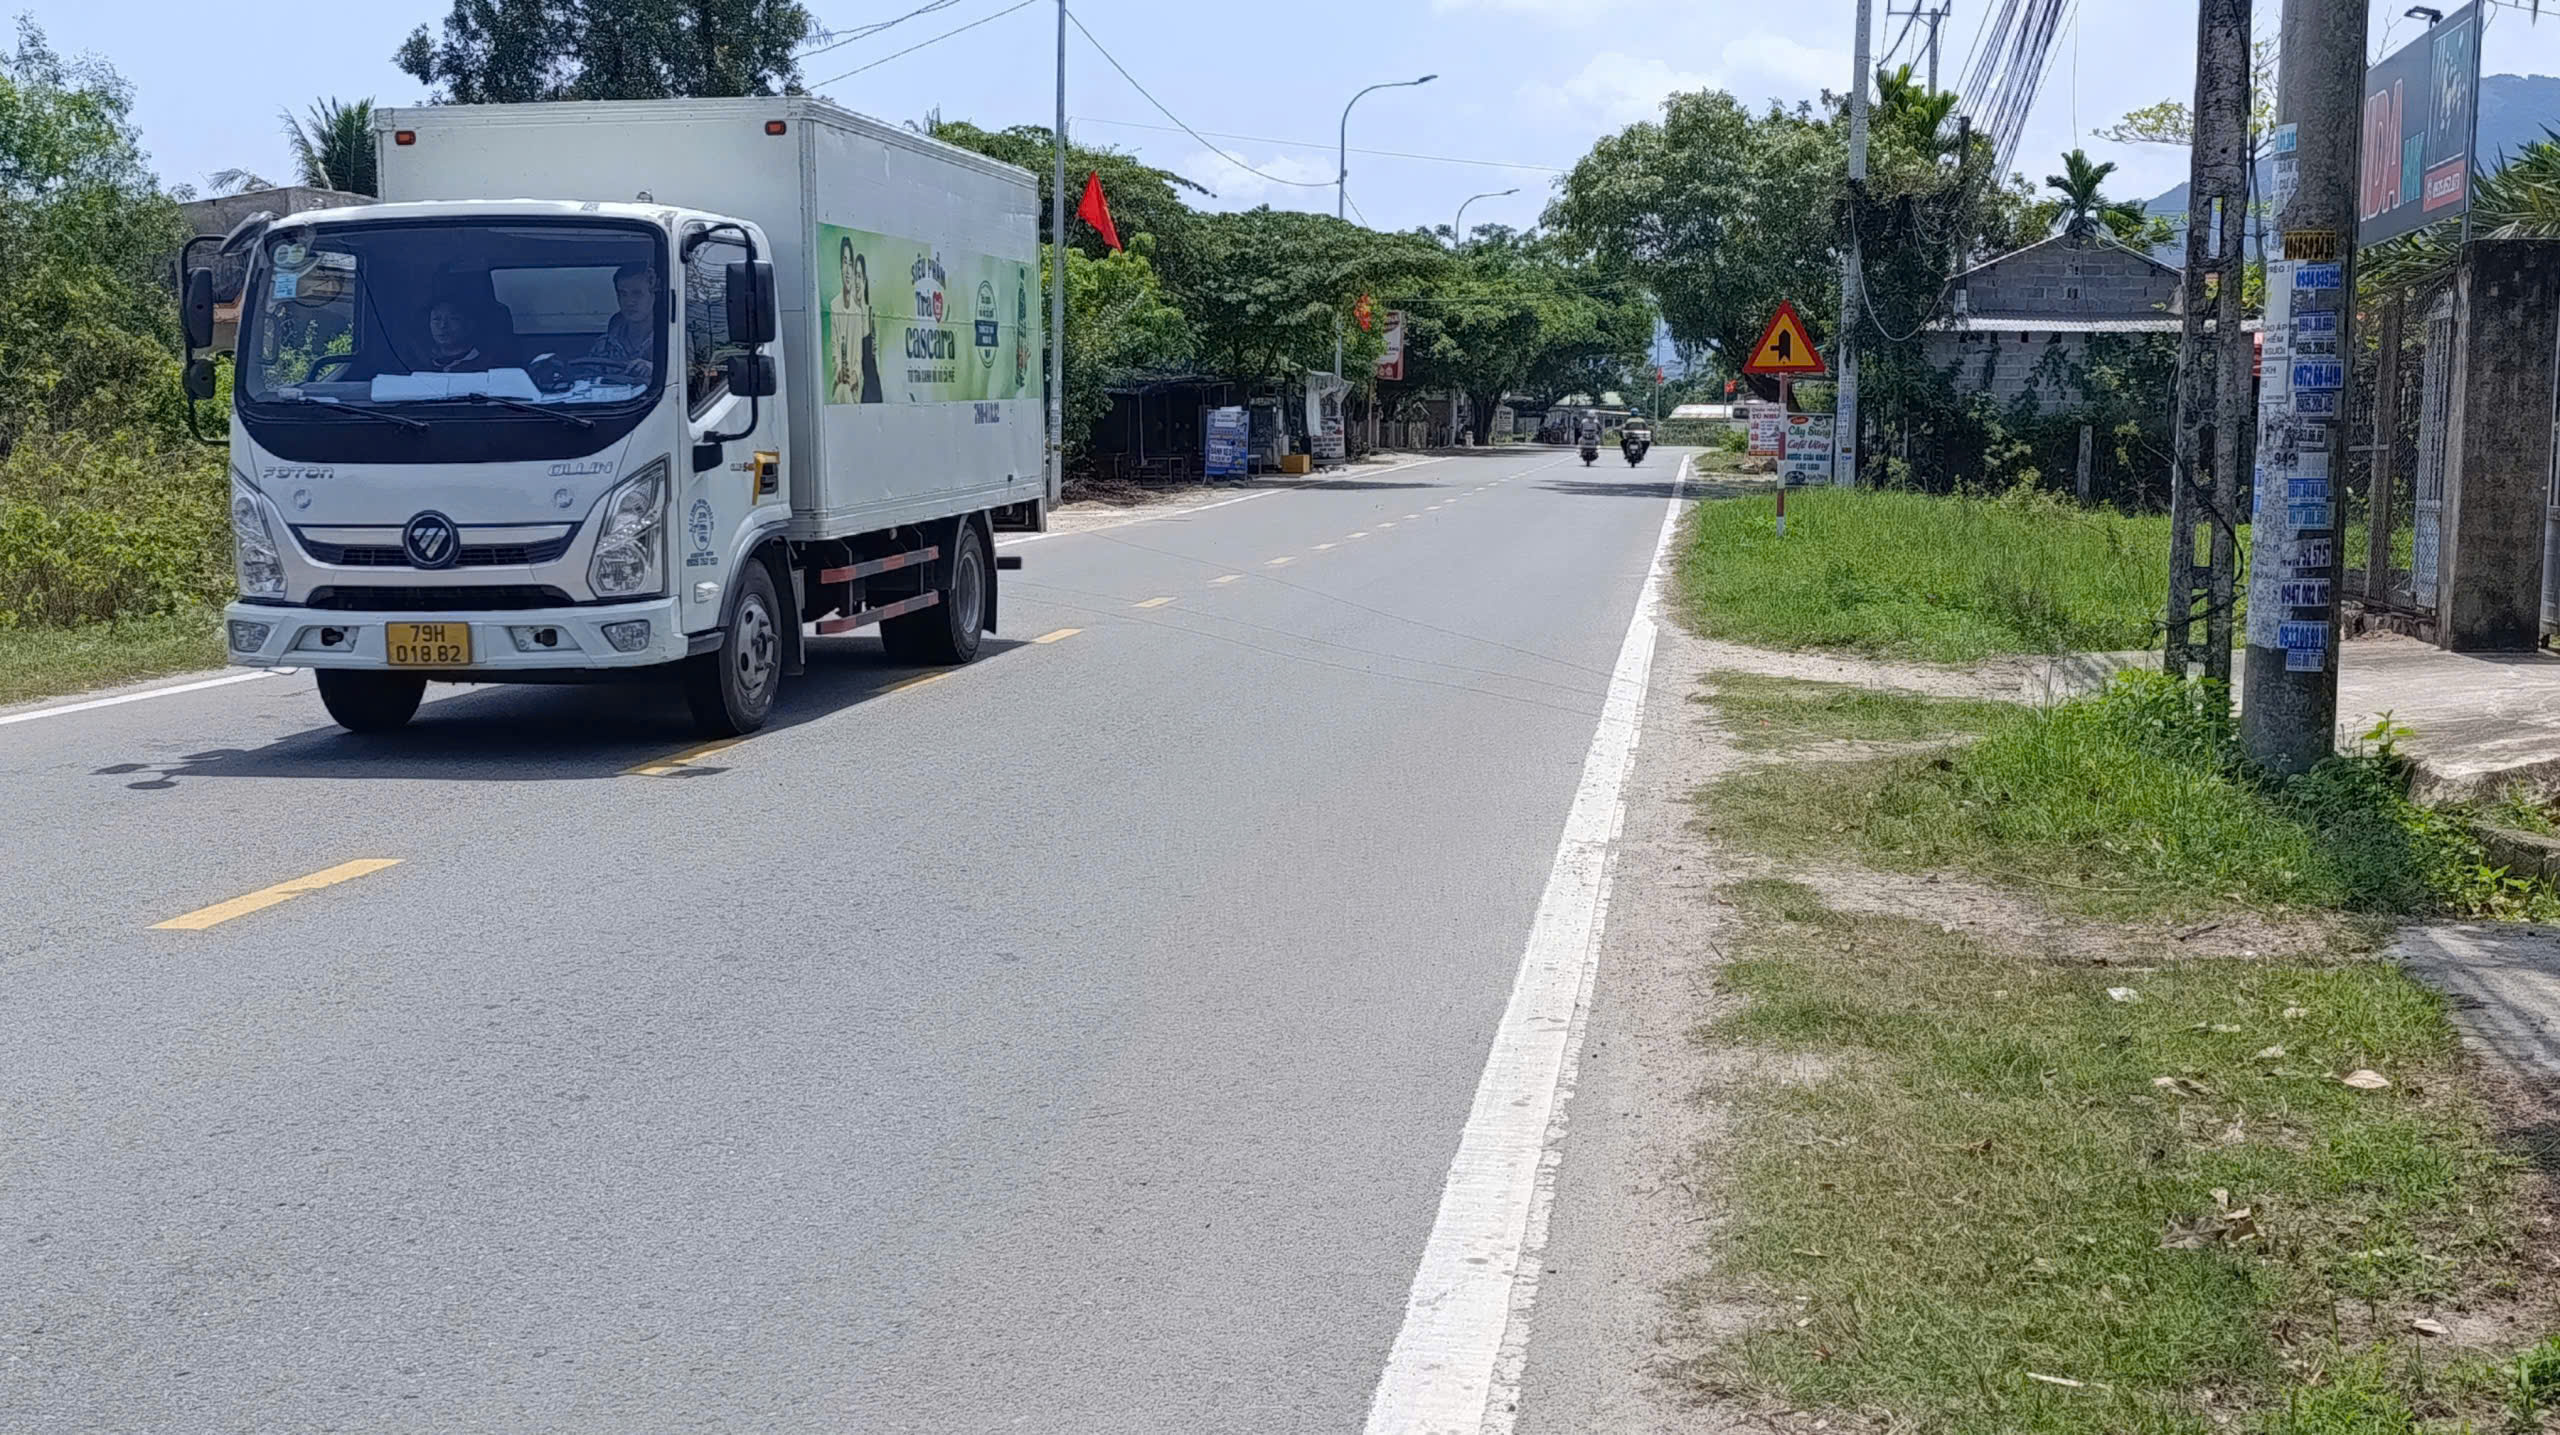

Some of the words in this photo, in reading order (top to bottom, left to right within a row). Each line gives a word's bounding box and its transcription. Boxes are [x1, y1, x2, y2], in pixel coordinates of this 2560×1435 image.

[905, 327, 956, 360] cascara
[263, 466, 335, 480] FOTON
[547, 461, 614, 478] OLLIN
[409, 625, 446, 643] 79H
[395, 644, 462, 663] 018.82
